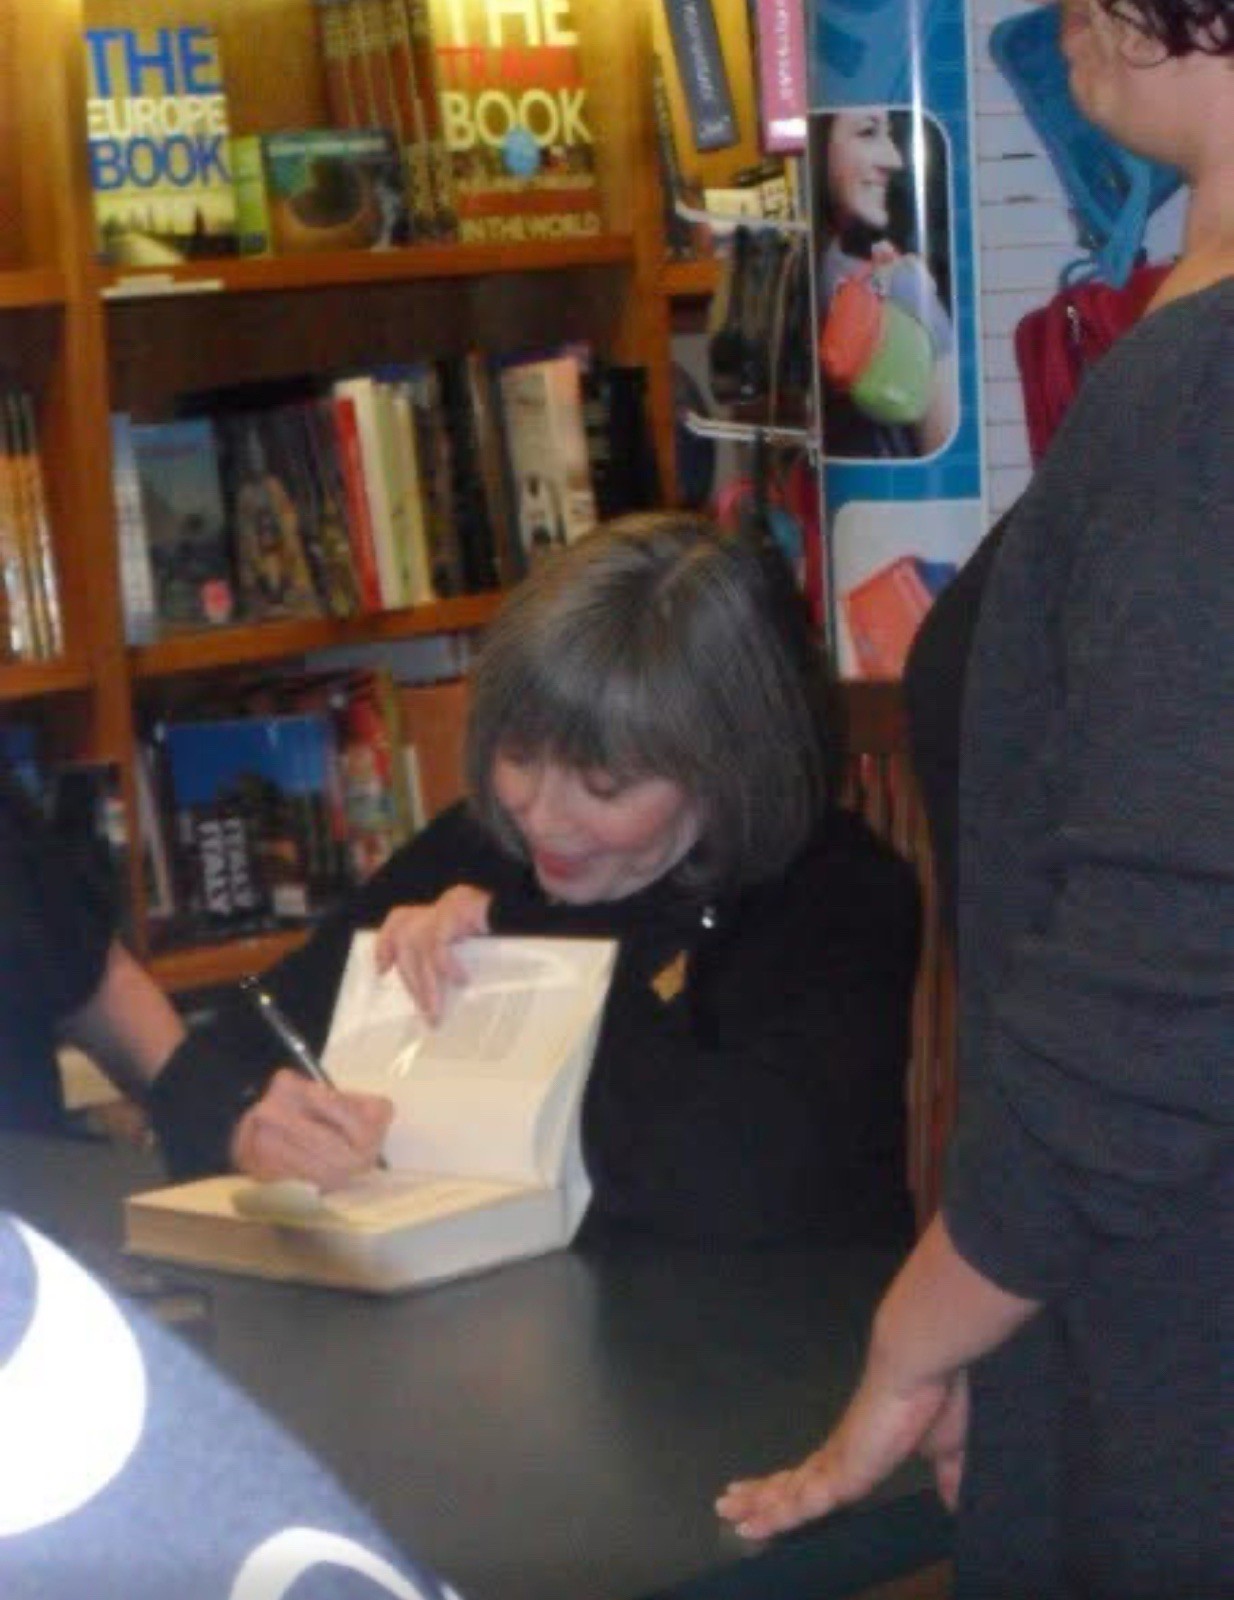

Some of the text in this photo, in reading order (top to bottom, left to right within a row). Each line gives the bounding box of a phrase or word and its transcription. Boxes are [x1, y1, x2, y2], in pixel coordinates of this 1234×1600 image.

[84, 27, 224, 99] THE
[87, 94, 229, 139] EUROPE
[440, 88, 592, 150] BOOK
[88, 135, 232, 189] BOOK
